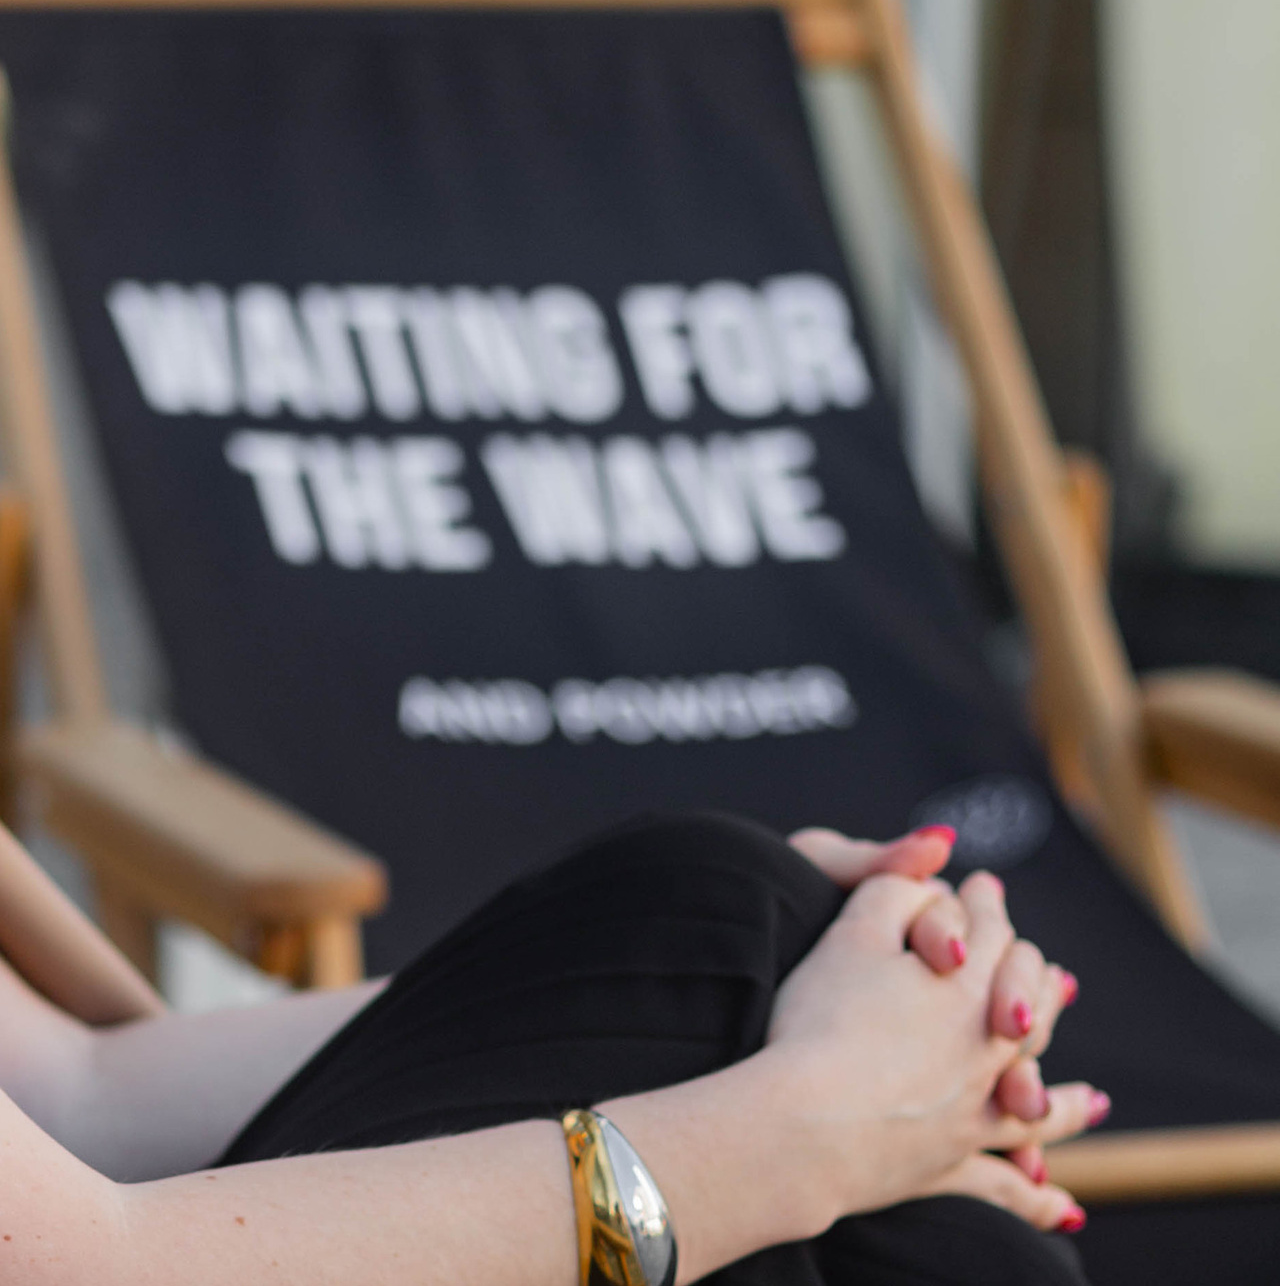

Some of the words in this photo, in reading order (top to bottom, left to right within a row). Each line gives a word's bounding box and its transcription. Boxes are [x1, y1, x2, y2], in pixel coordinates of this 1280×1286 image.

[107, 280, 622, 424] WAITING
[617, 271, 872, 420] FOR
[226, 429, 492, 572] THE
[479, 427, 845, 569] WAVE
[399, 672, 552, 745] AND
[554, 665, 854, 745] POWDER
